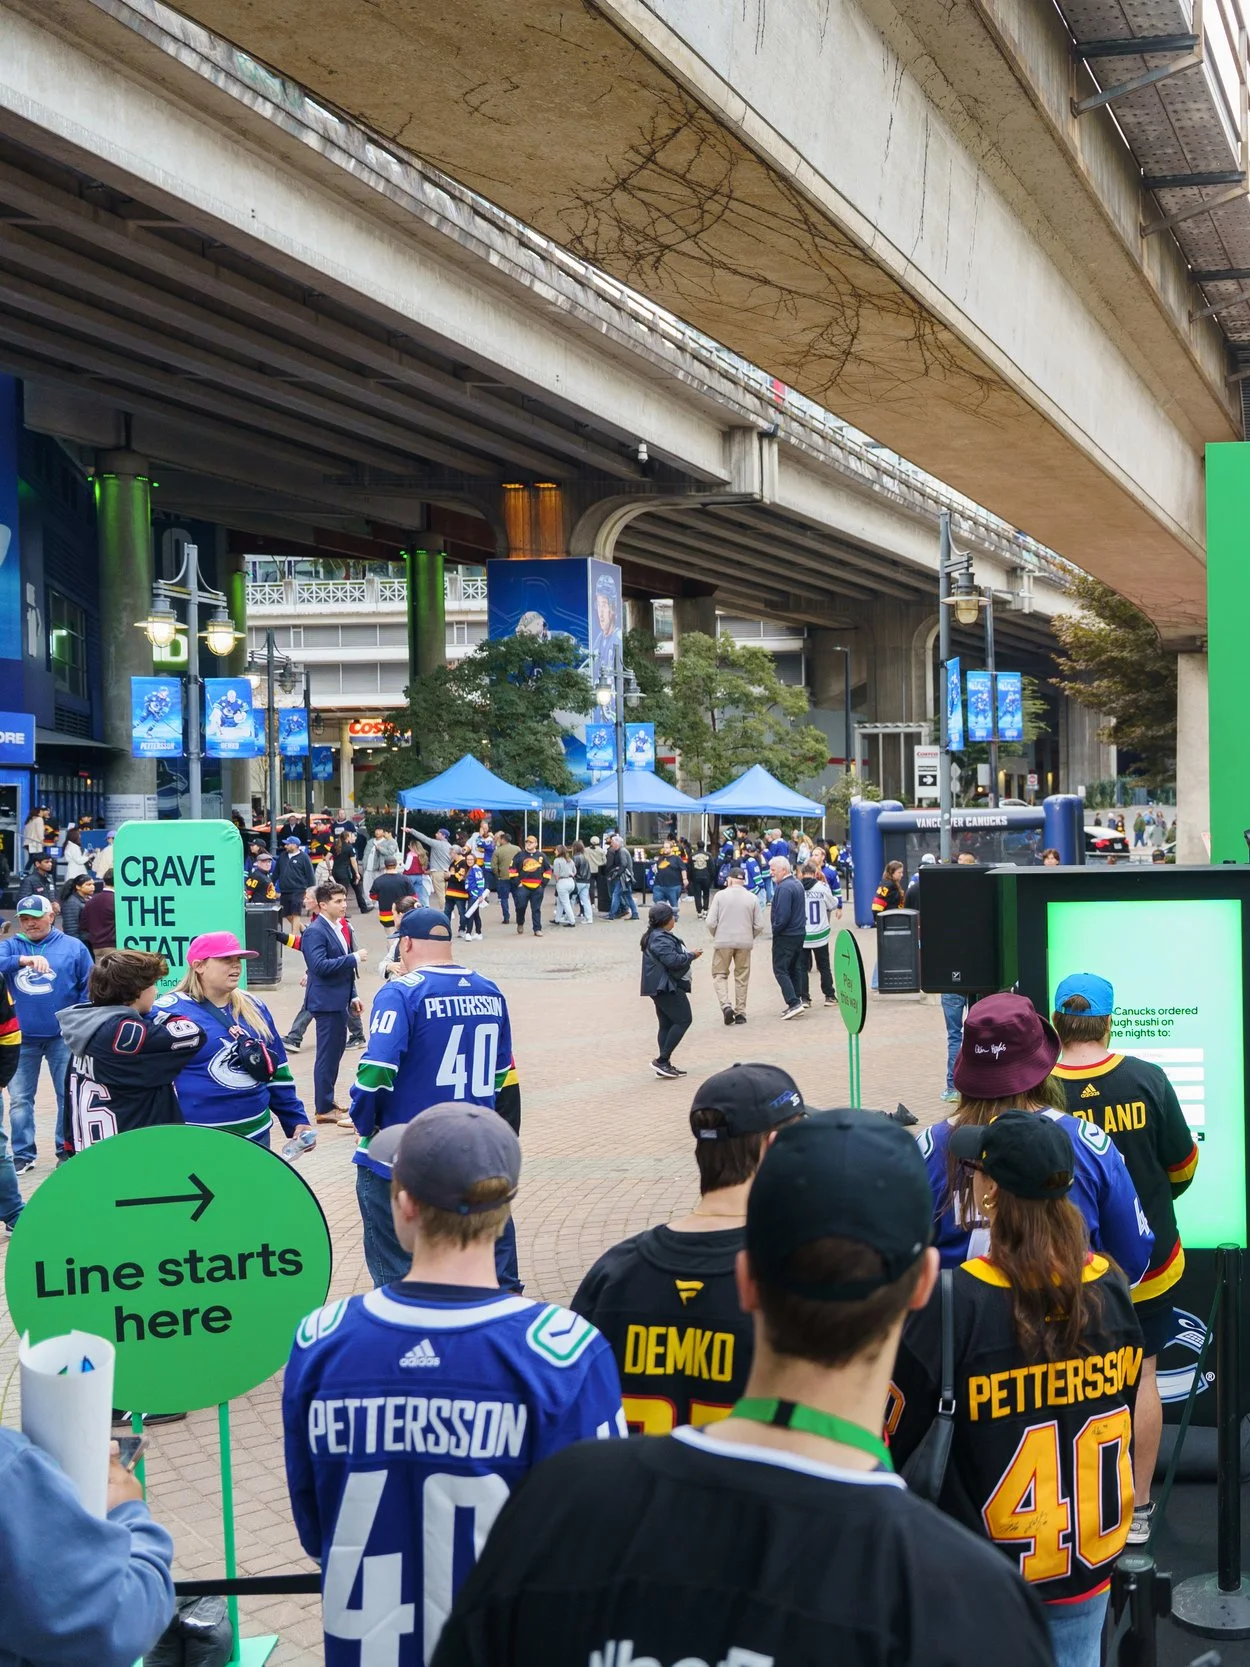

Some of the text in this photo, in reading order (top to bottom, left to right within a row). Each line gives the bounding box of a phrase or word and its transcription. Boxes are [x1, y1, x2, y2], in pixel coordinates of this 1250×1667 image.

[349, 722, 398, 735] COS
[916, 815, 1008, 828] VANCVER CANUCKS
[121, 855, 216, 887] CRAVE
[121, 896, 176, 927] THE
[809, 900, 821, 925] 0
[123, 935, 200, 967] STAT
[369, 1010, 398, 1034] 40
[424, 995, 503, 1019] PETTERSSON
[1114, 1006, 1199, 1016] Canucks ordered
[1135, 1017, 1160, 1027] sushi
[1125, 1028, 1156, 1040] nights
[1158, 1028, 1171, 1038] to:
[435, 1023, 500, 1100] 40
[69, 1073, 119, 1154] 16
[35, 1242, 304, 1299] Line starts
[114, 1303, 234, 1343] here
[398, 1355, 441, 1368] adidas
[623, 1323, 735, 1383] DEMKO
[968, 1345, 1144, 1421] PETTERSSON
[308, 1396, 528, 1459] PETTERSSON
[982, 1404, 1136, 1585] 40
[322, 1468, 512, 1667] 40
